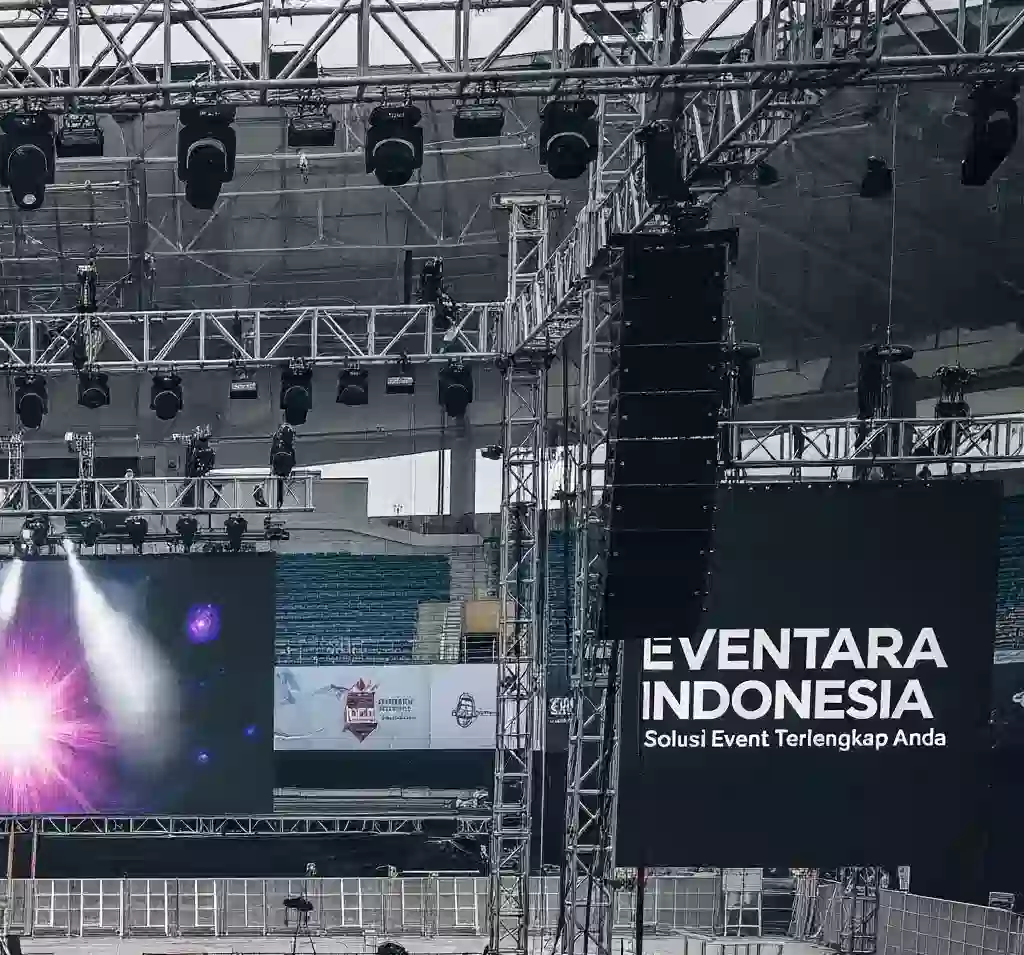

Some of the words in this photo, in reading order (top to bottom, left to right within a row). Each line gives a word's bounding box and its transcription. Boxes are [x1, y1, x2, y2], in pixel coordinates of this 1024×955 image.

[643, 628, 949, 671] EVENTARA
[643, 679, 934, 720] INDONESIA
[643, 729, 706, 748] Solusi
[712, 730, 770, 748] Event
[775, 728, 889, 751] Terlengkap
[893, 728, 947, 747] Anda
